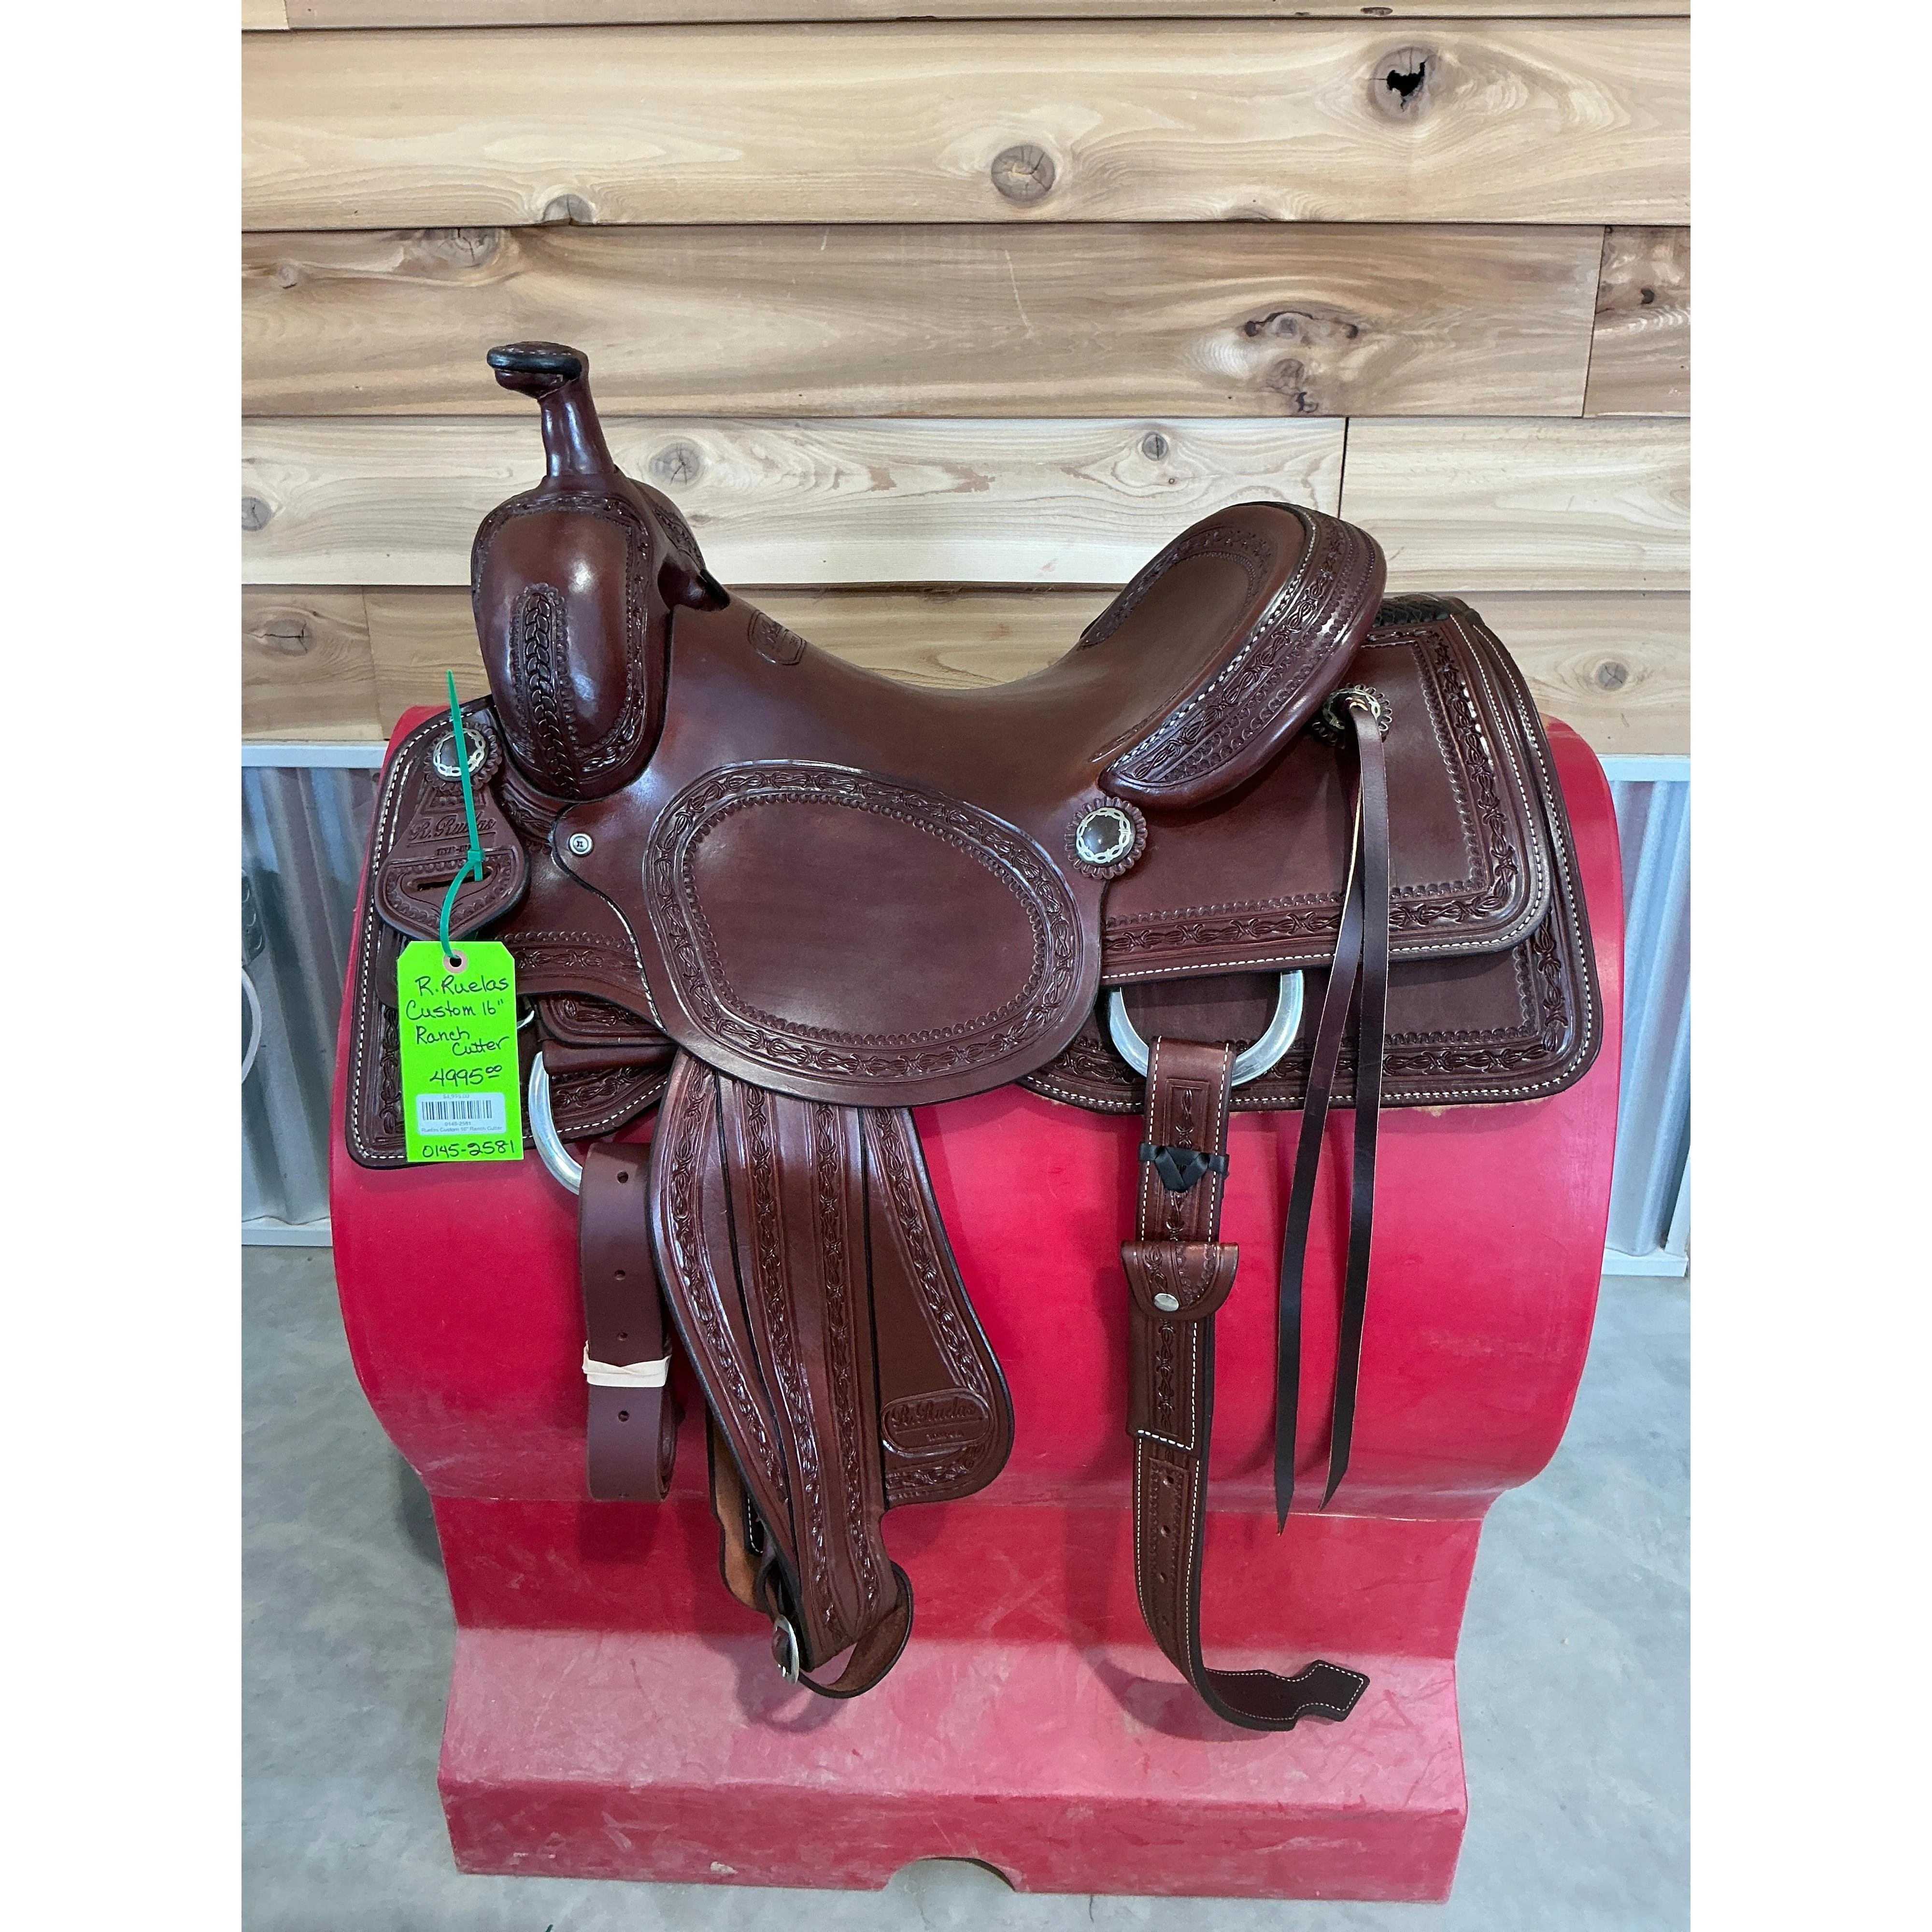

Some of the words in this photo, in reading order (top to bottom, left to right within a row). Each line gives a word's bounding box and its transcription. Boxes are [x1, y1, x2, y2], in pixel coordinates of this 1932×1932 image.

[435, 811, 497, 837] Rulas
[406, 999, 476, 1020] Custom
[483, 998, 503, 1015] 16"
[416, 1025, 470, 1044] Ranch
[452, 1036, 510, 1056] Cutter
[422, 1139, 514, 1158] 0145-2581
